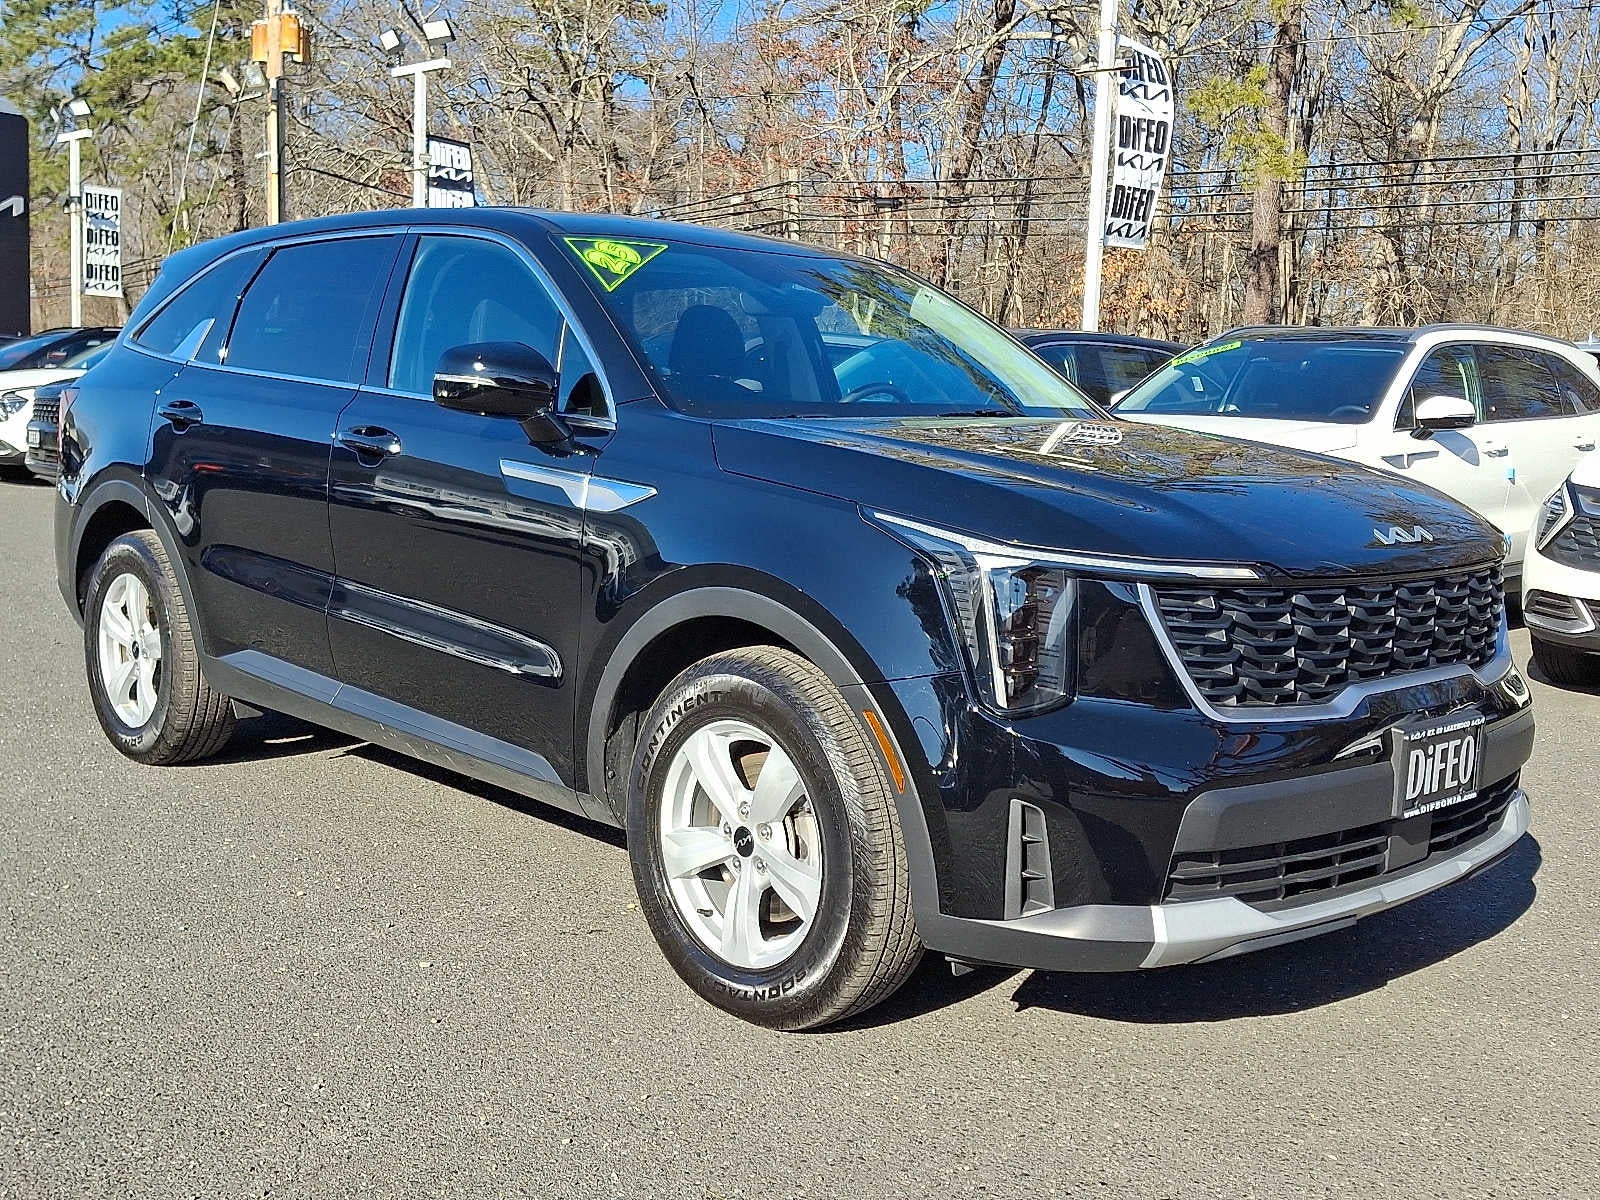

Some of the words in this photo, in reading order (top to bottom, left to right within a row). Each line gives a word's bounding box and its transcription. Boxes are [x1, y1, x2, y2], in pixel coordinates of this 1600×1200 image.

[1119, 114, 1168, 154] DiFEO
[86, 192, 118, 211] DiFEO
[1111, 184, 1155, 222] DiFEO
[87, 228, 118, 246] DiFEO
[86, 263, 118, 281] DiFEO
[1405, 735, 1475, 800] DiFEO
